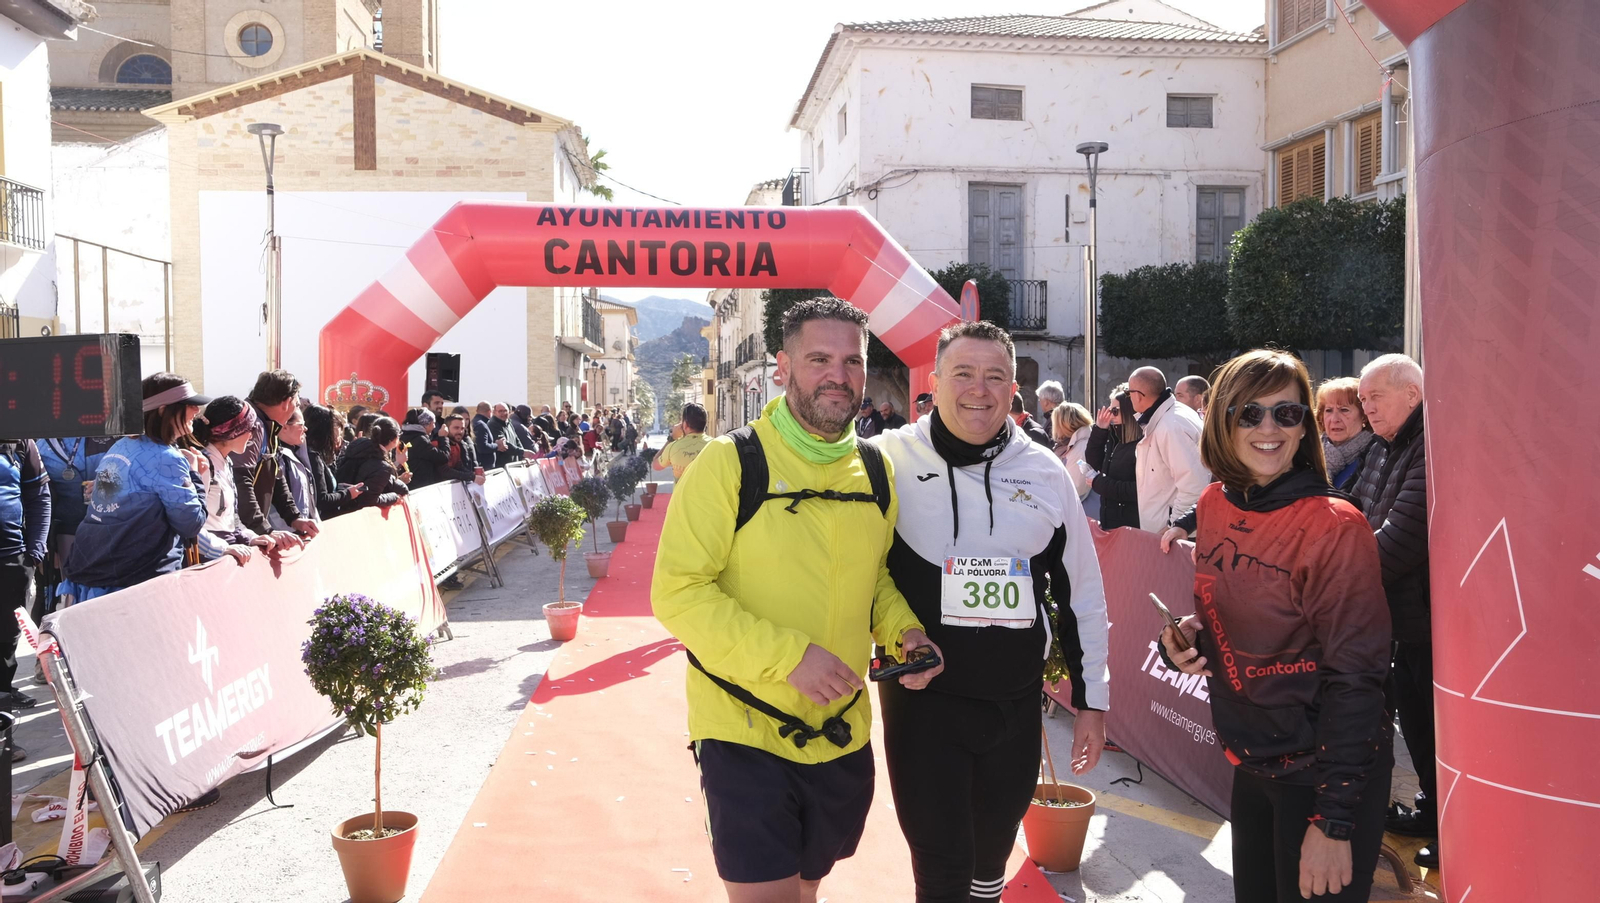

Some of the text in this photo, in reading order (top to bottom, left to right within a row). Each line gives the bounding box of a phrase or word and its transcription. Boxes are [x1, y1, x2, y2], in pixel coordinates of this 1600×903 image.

[536, 206, 787, 230] AYUNTAMIENTO
[543, 238, 779, 277] CANTORIA
[1010, 478, 1031, 486] LEGIÓN
[953, 568, 965, 576] LA
[967, 567, 1007, 577] PÓLVORA
[957, 558, 992, 567] IV CxM
[962, 581, 1020, 610] 380
[1201, 582, 1212, 605] LA
[1245, 659, 1317, 678] Cantoria
[155, 662, 273, 766] TEAMERGY
[1150, 699, 1217, 745] www.teamergy.es
[74, 808, 85, 825] EL
